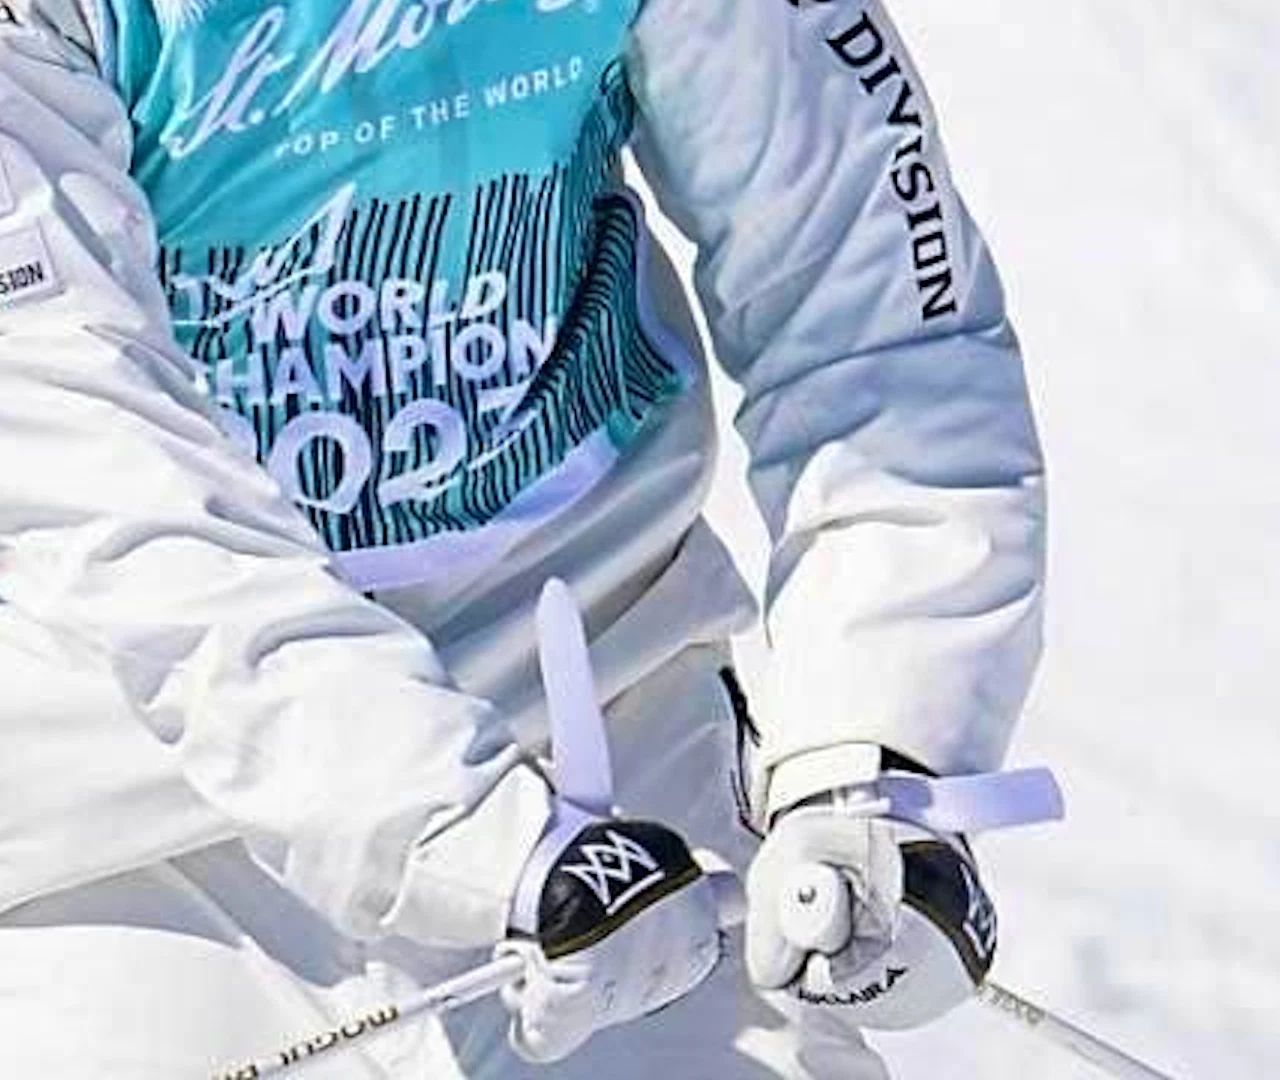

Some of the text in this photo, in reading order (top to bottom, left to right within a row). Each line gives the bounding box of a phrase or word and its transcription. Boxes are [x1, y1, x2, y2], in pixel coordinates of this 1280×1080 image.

[356, 119, 396, 145] OF
[413, 93, 471, 123] THE
[485, 56, 585, 109] WORLD
[826, 12, 959, 322] DIVISION
[250, 271, 508, 343] WORLD
[213, 314, 559, 406] HAMPION
